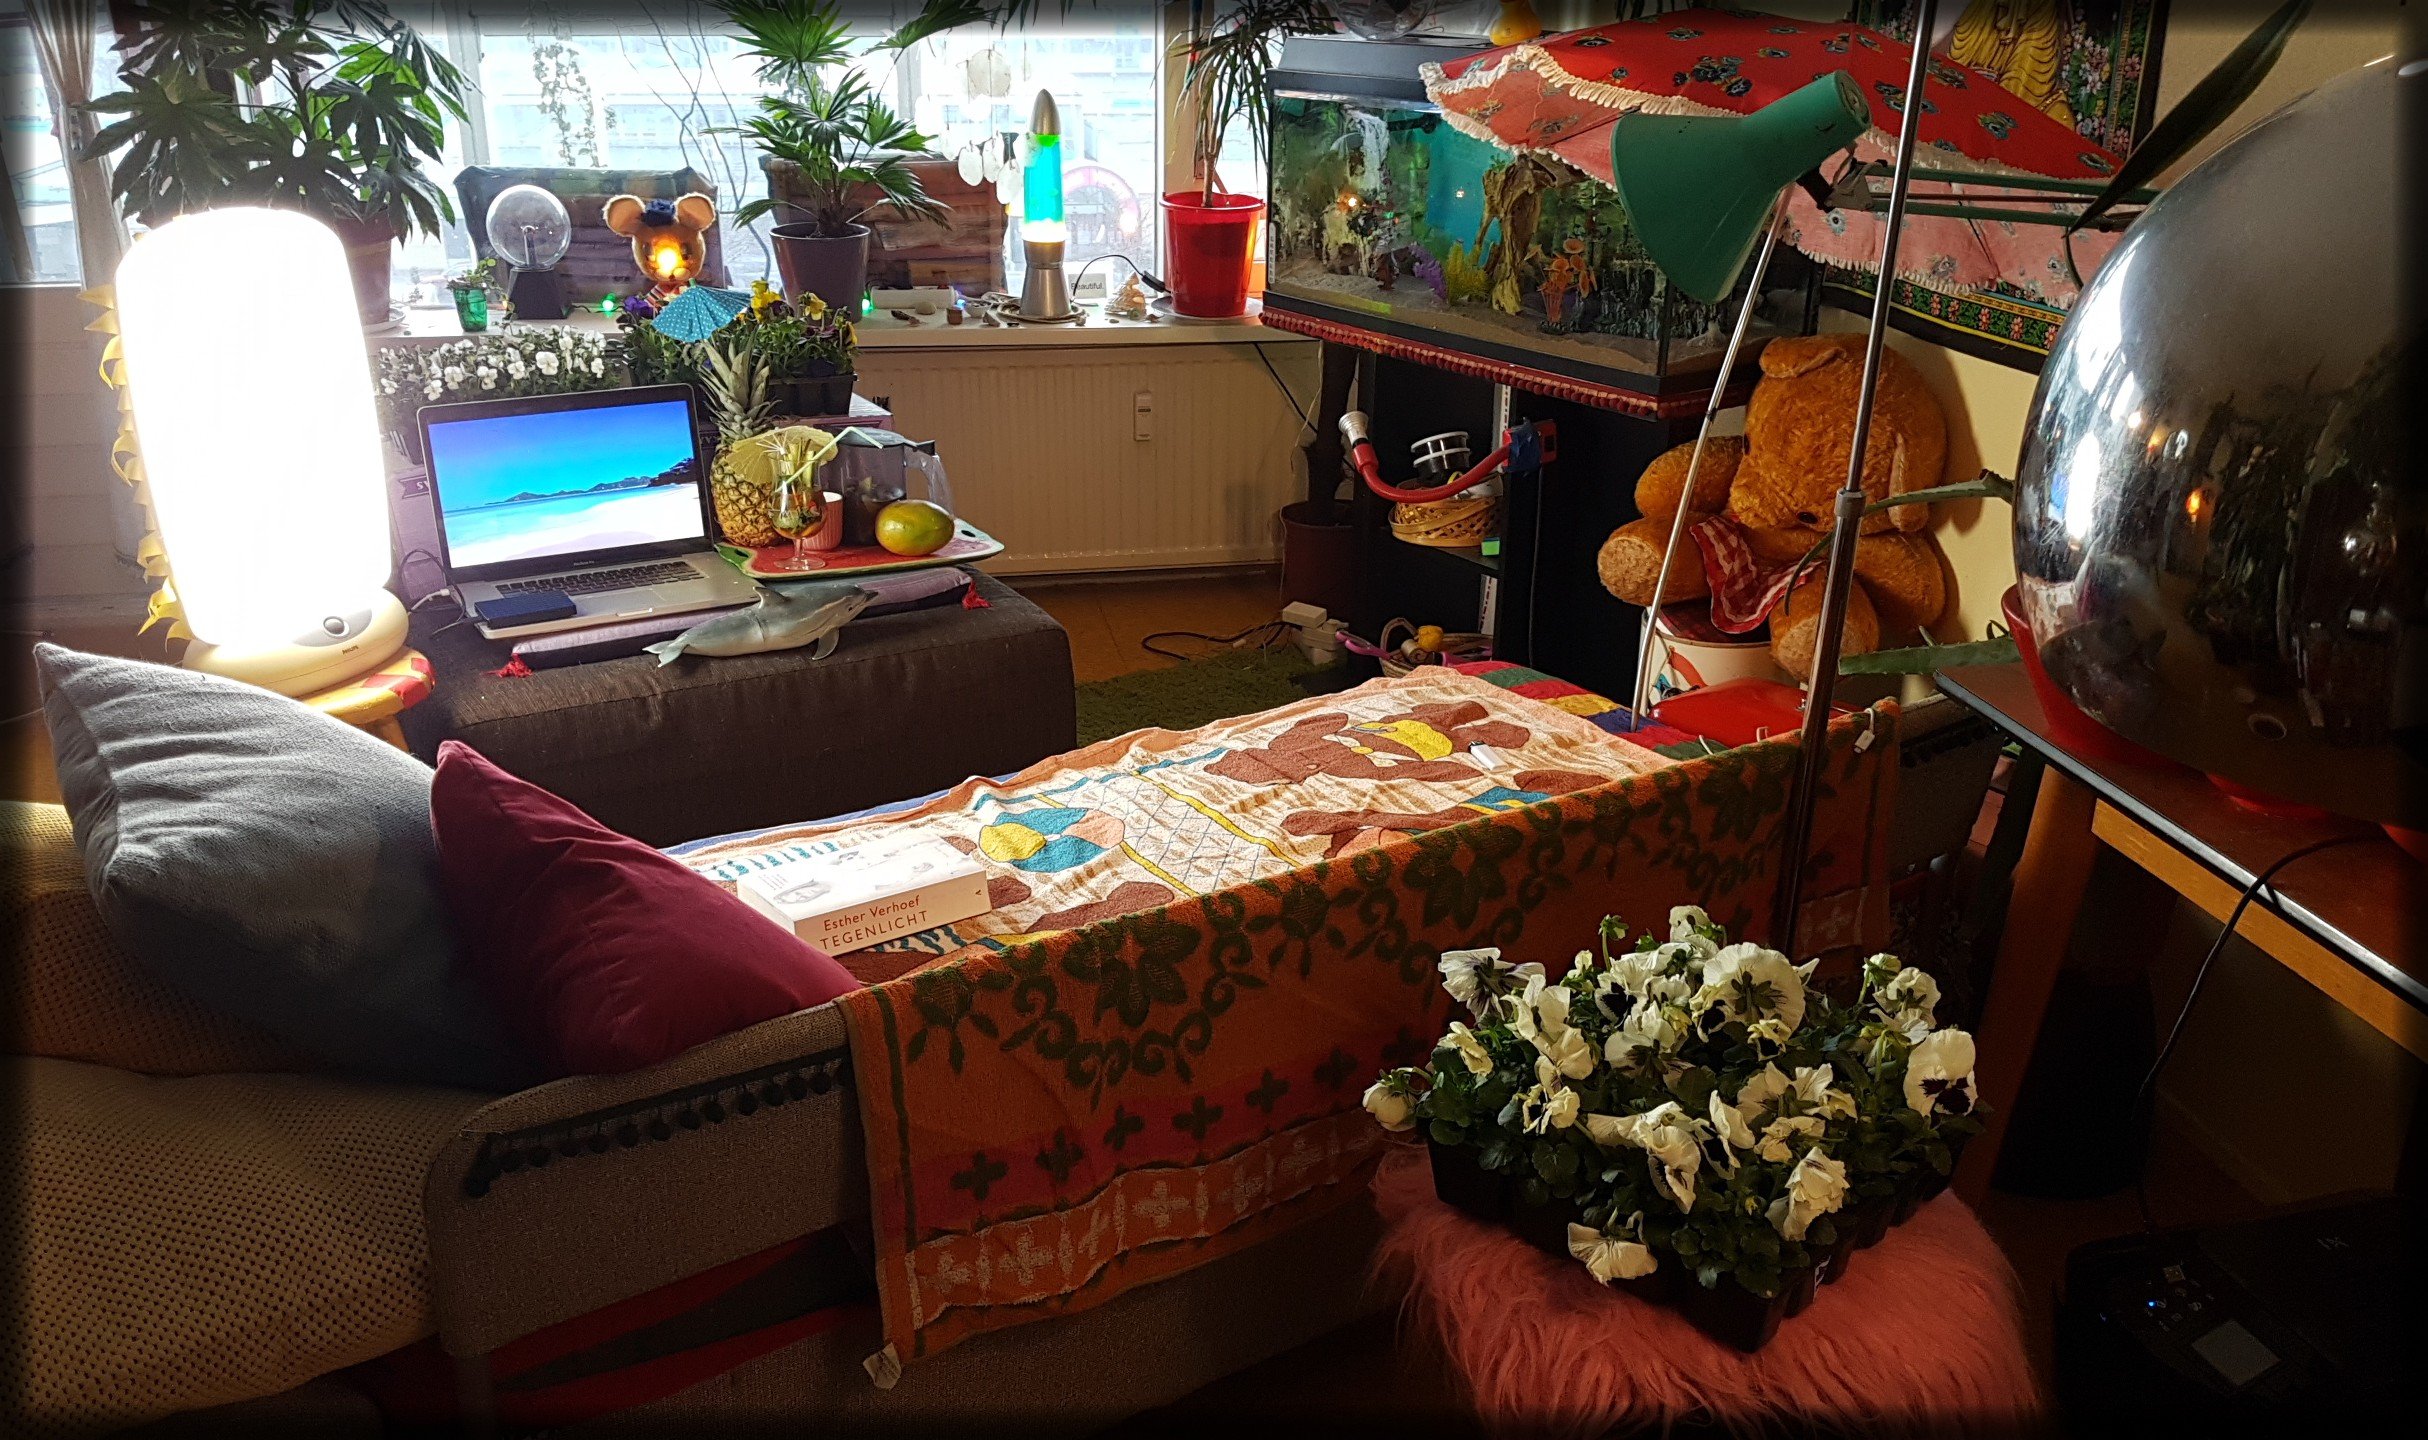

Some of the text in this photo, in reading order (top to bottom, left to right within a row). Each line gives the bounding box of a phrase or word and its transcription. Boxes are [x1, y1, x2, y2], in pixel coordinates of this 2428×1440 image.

[819, 910, 928, 950] TEGENLICHT
[824, 894, 920, 931] Esther Verhoef
